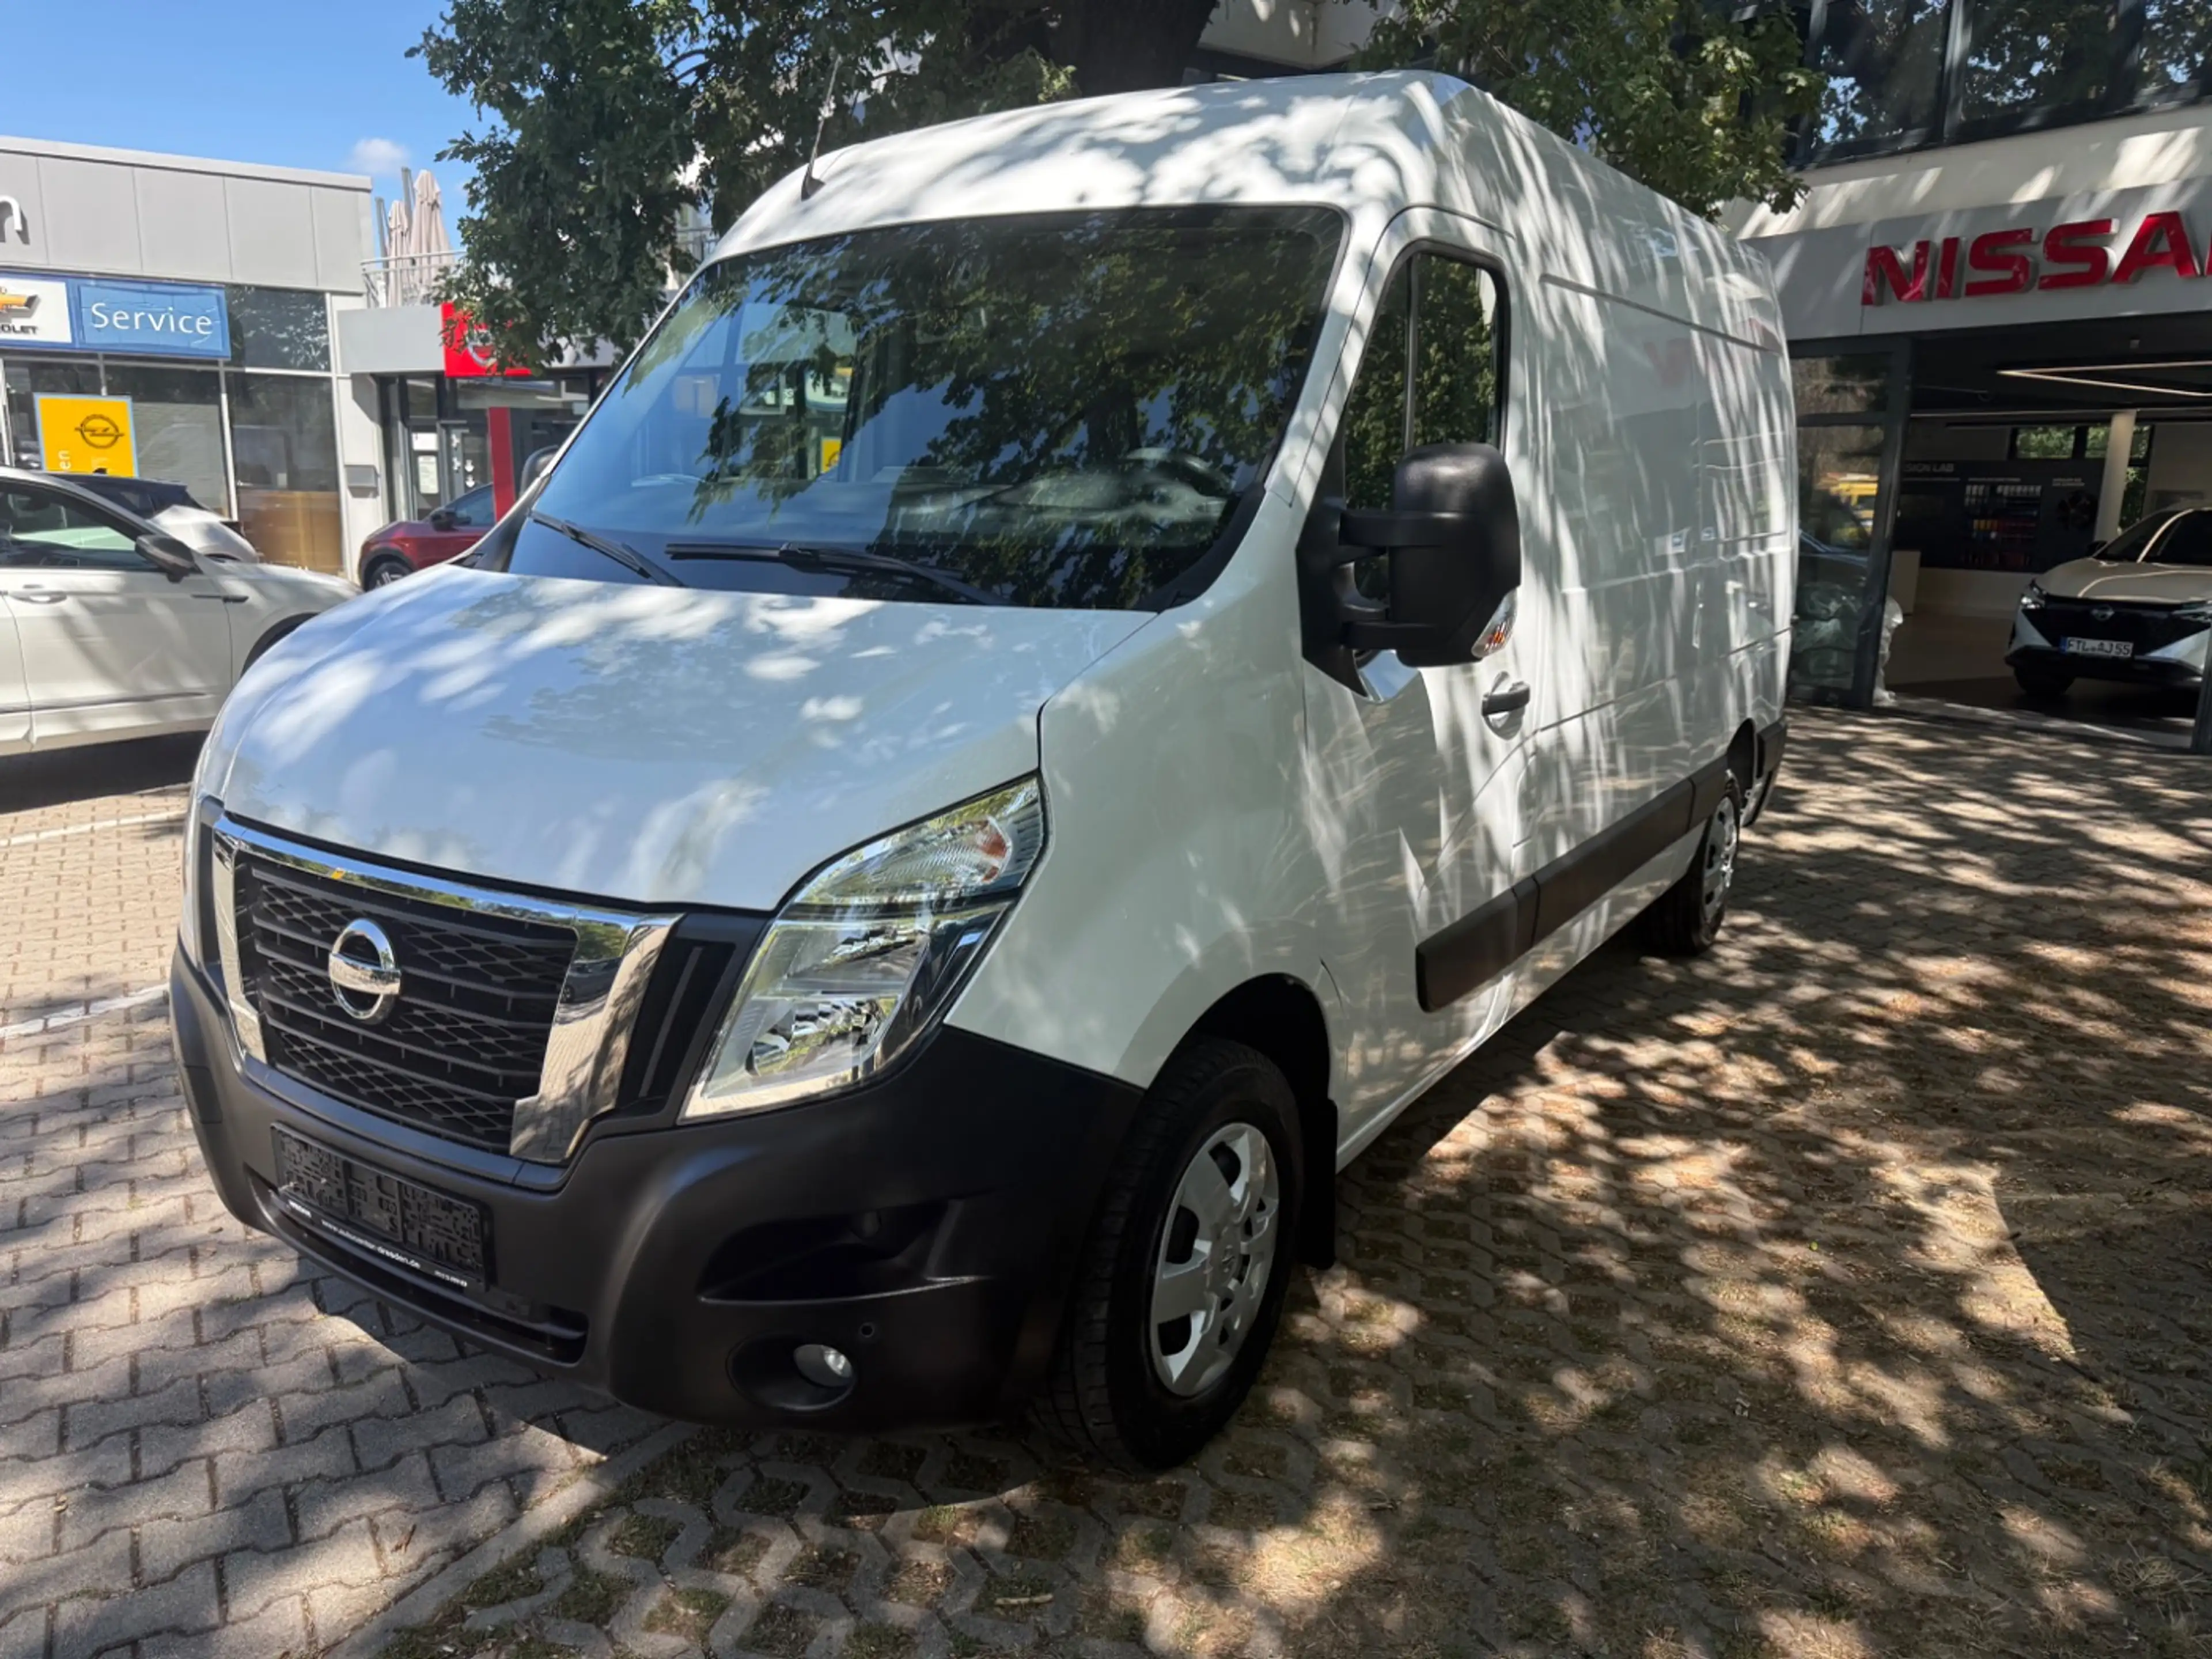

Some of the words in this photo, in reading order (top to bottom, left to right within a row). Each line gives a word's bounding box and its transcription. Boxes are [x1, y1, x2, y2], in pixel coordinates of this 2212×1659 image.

[1861, 210, 2212, 306] NISSA
[0, 324, 39, 335] OLET
[91, 302, 213, 335] Service
